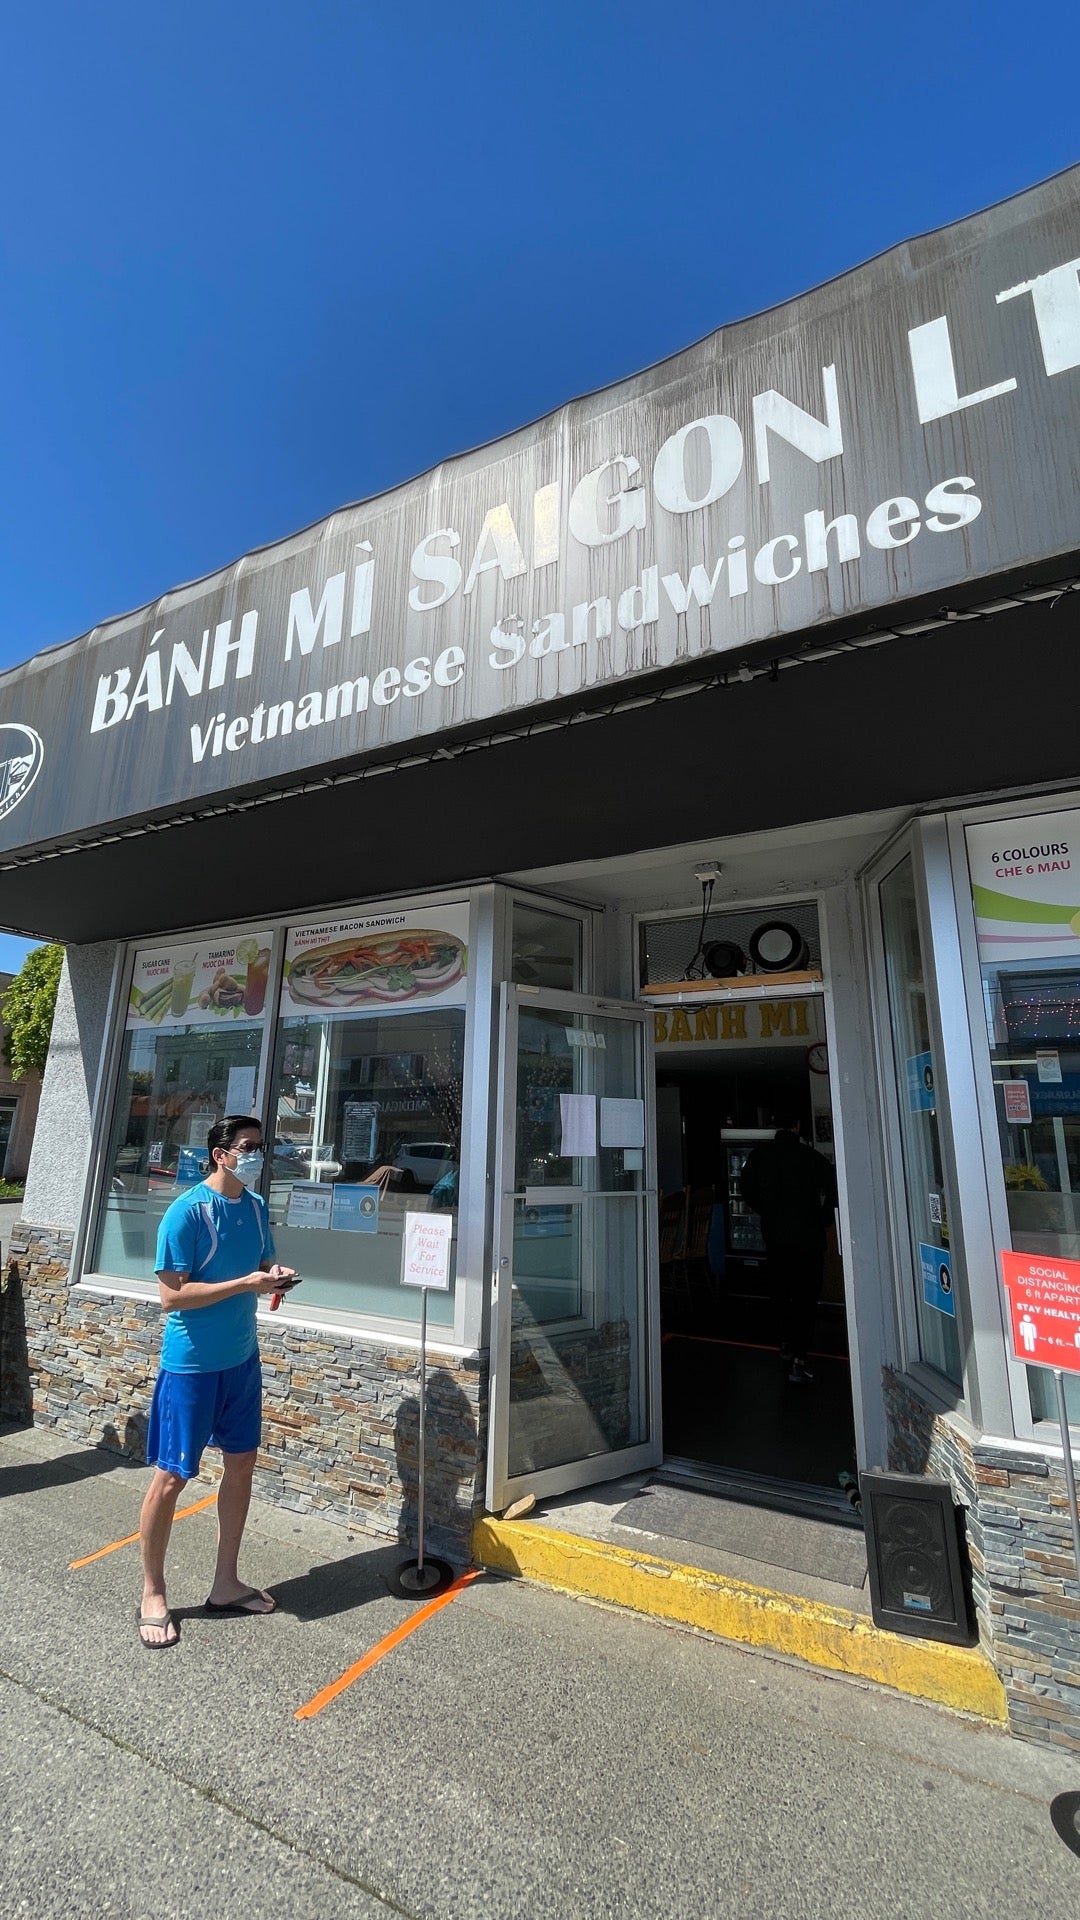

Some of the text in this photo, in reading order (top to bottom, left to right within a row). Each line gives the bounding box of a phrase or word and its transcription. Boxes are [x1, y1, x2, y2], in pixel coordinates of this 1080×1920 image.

[90, 628, 259, 733] BÁNH
[284, 540, 375, 662] MÌ
[408, 363, 844, 613] SAIGON
[190, 476, 983, 764] Vietnamese Sandwiches
[991, 842, 1069, 863] 6 COLOURS
[995, 860, 1071, 878] CHE 6 MAU
[295, 916, 406, 938] VIETNAMESE BACON SANDWICH
[208, 948, 236, 960] TAMARIND
[413, 1223, 446, 1238] Please
[417, 1237, 440, 1250] Wait
[419, 1251, 436, 1262] For
[409, 1262, 445, 1278] Service
[1029, 1266, 1069, 1281] SOCIAL
[1025, 1289, 1032, 1297] 6
[1043, 1292, 1080, 1306] APART
[1016, 1302, 1041, 1314] STAY
